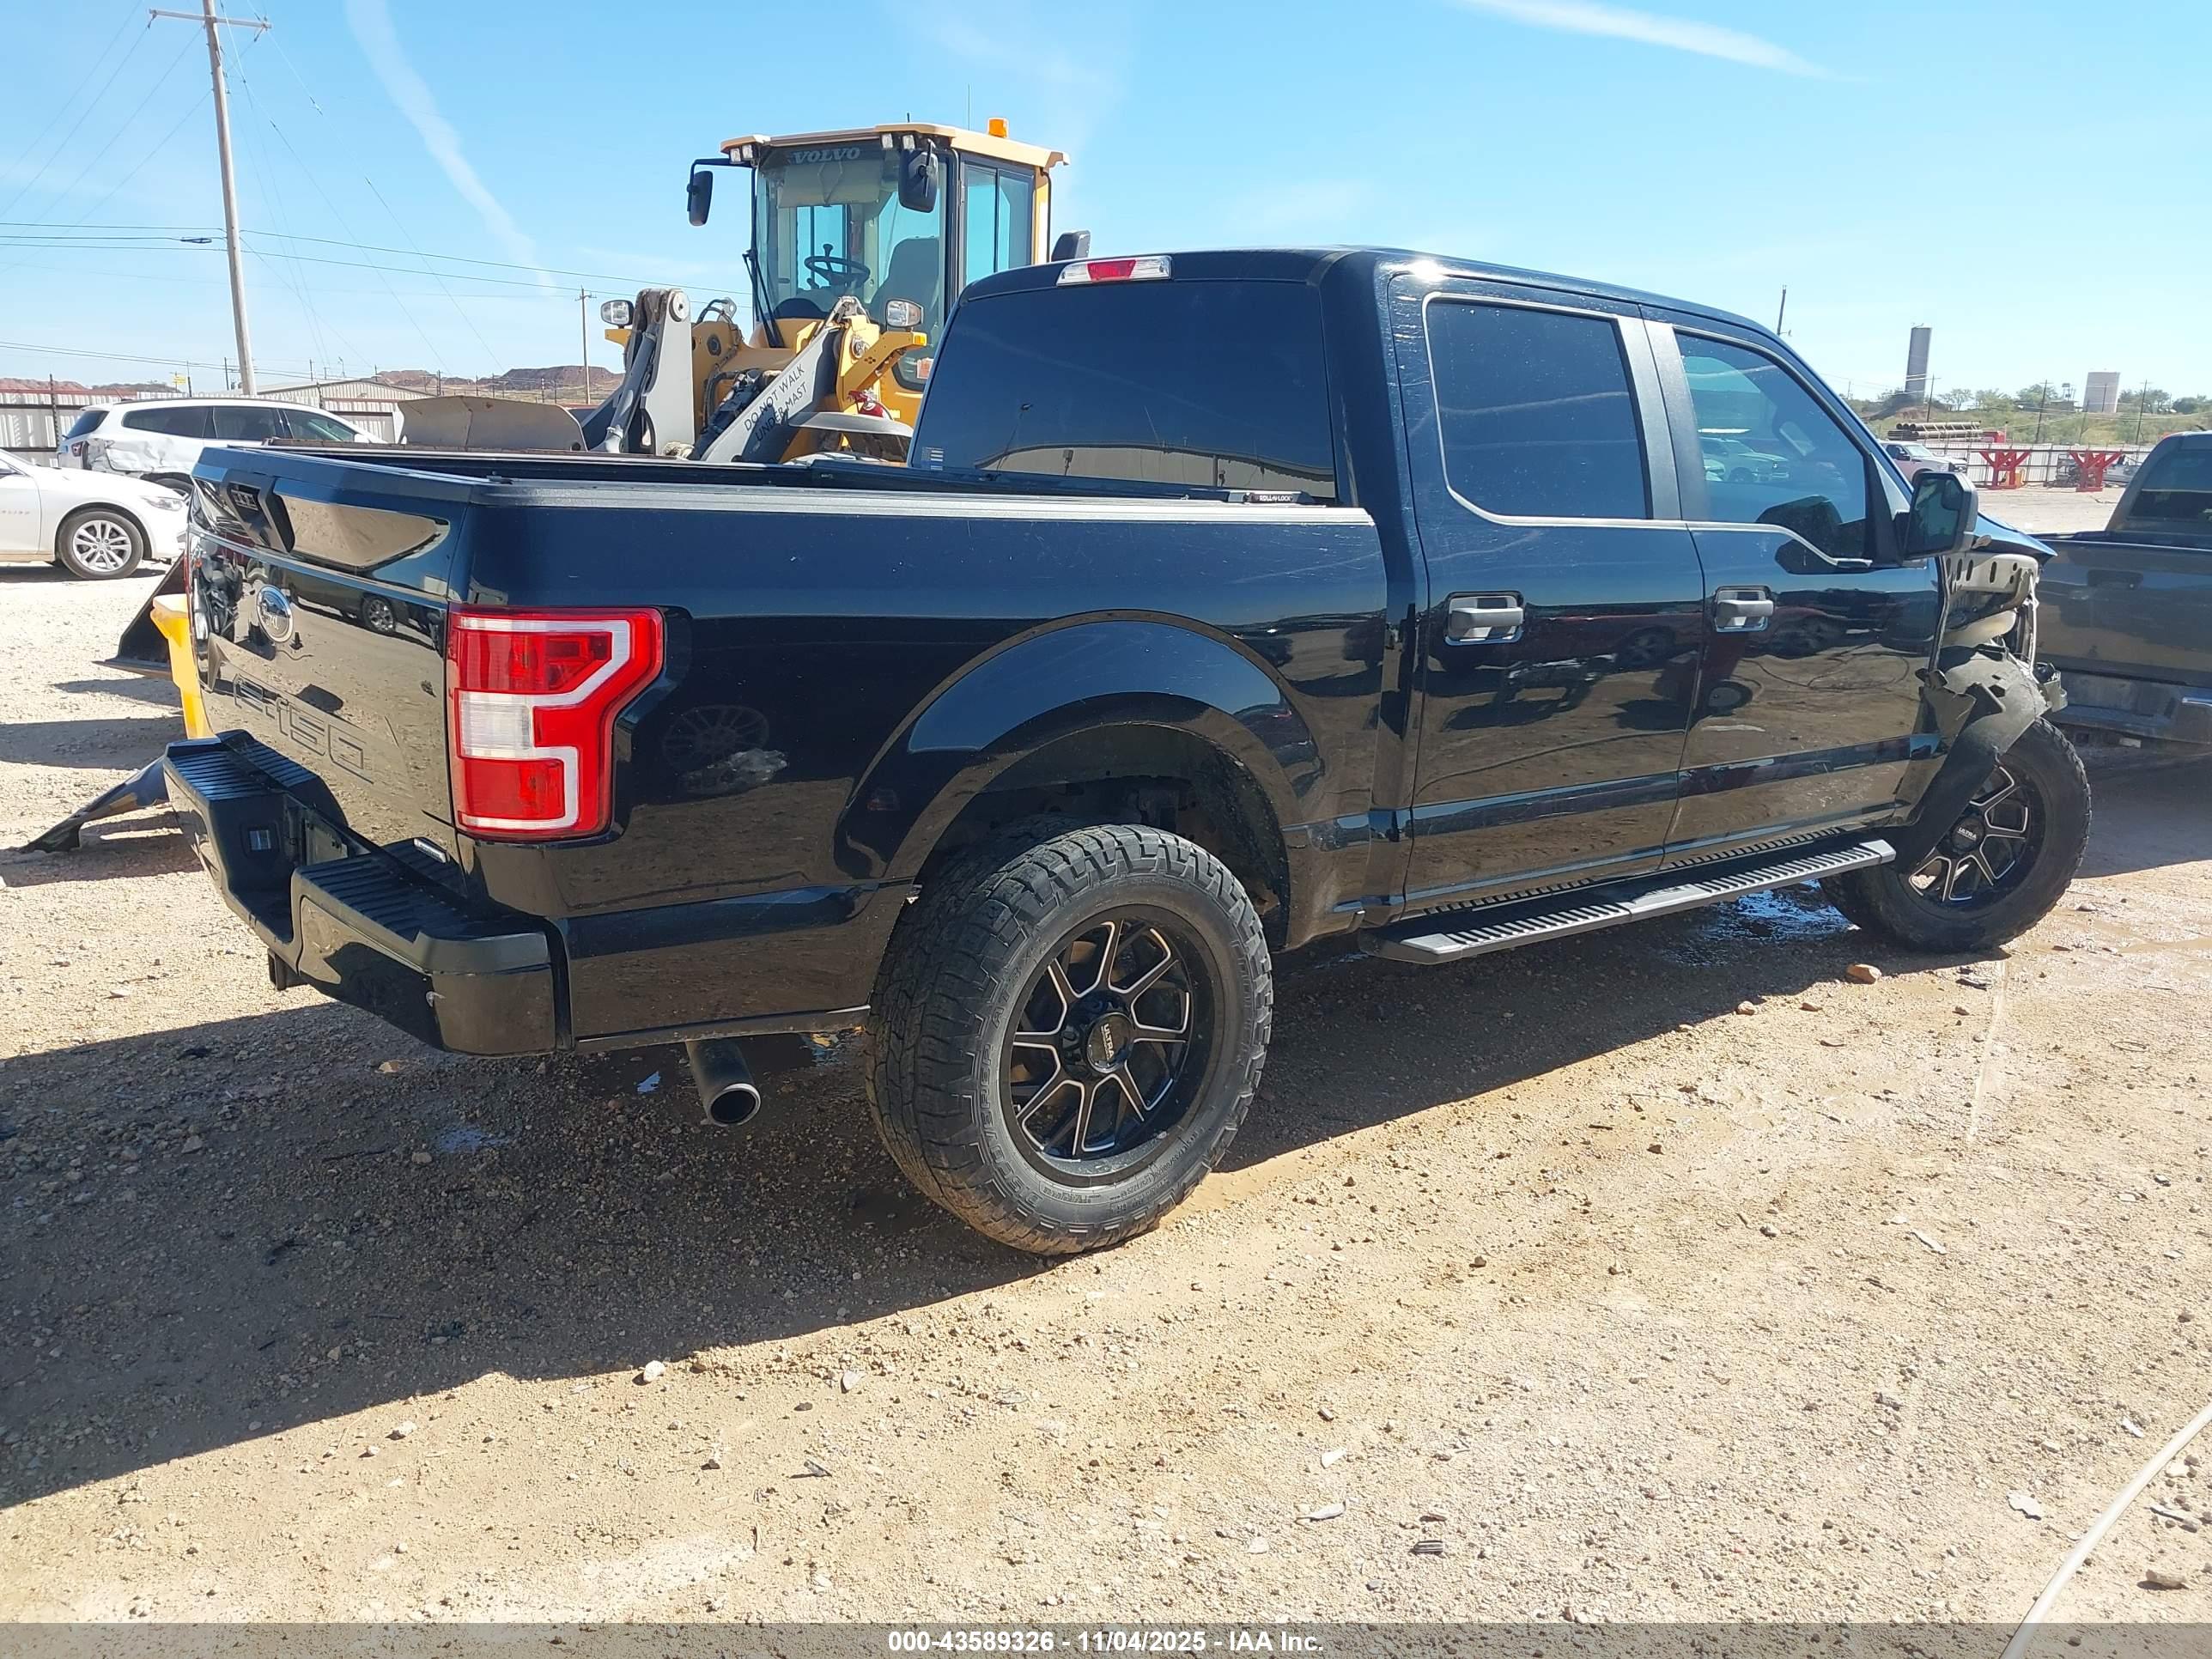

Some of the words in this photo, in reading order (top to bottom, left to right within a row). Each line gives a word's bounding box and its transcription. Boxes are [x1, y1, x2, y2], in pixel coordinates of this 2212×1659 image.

[793, 147, 860, 164] VOLVO
[744, 411, 759, 431] DO
[759, 389, 779, 416] NOT
[779, 364, 805, 393] WALK
[756, 407, 786, 441] UNDER
[785, 381, 807, 412] MAST
[1958, 827, 1976, 838] ULTRA
[1103, 1024, 1115, 1059] ULTRA
